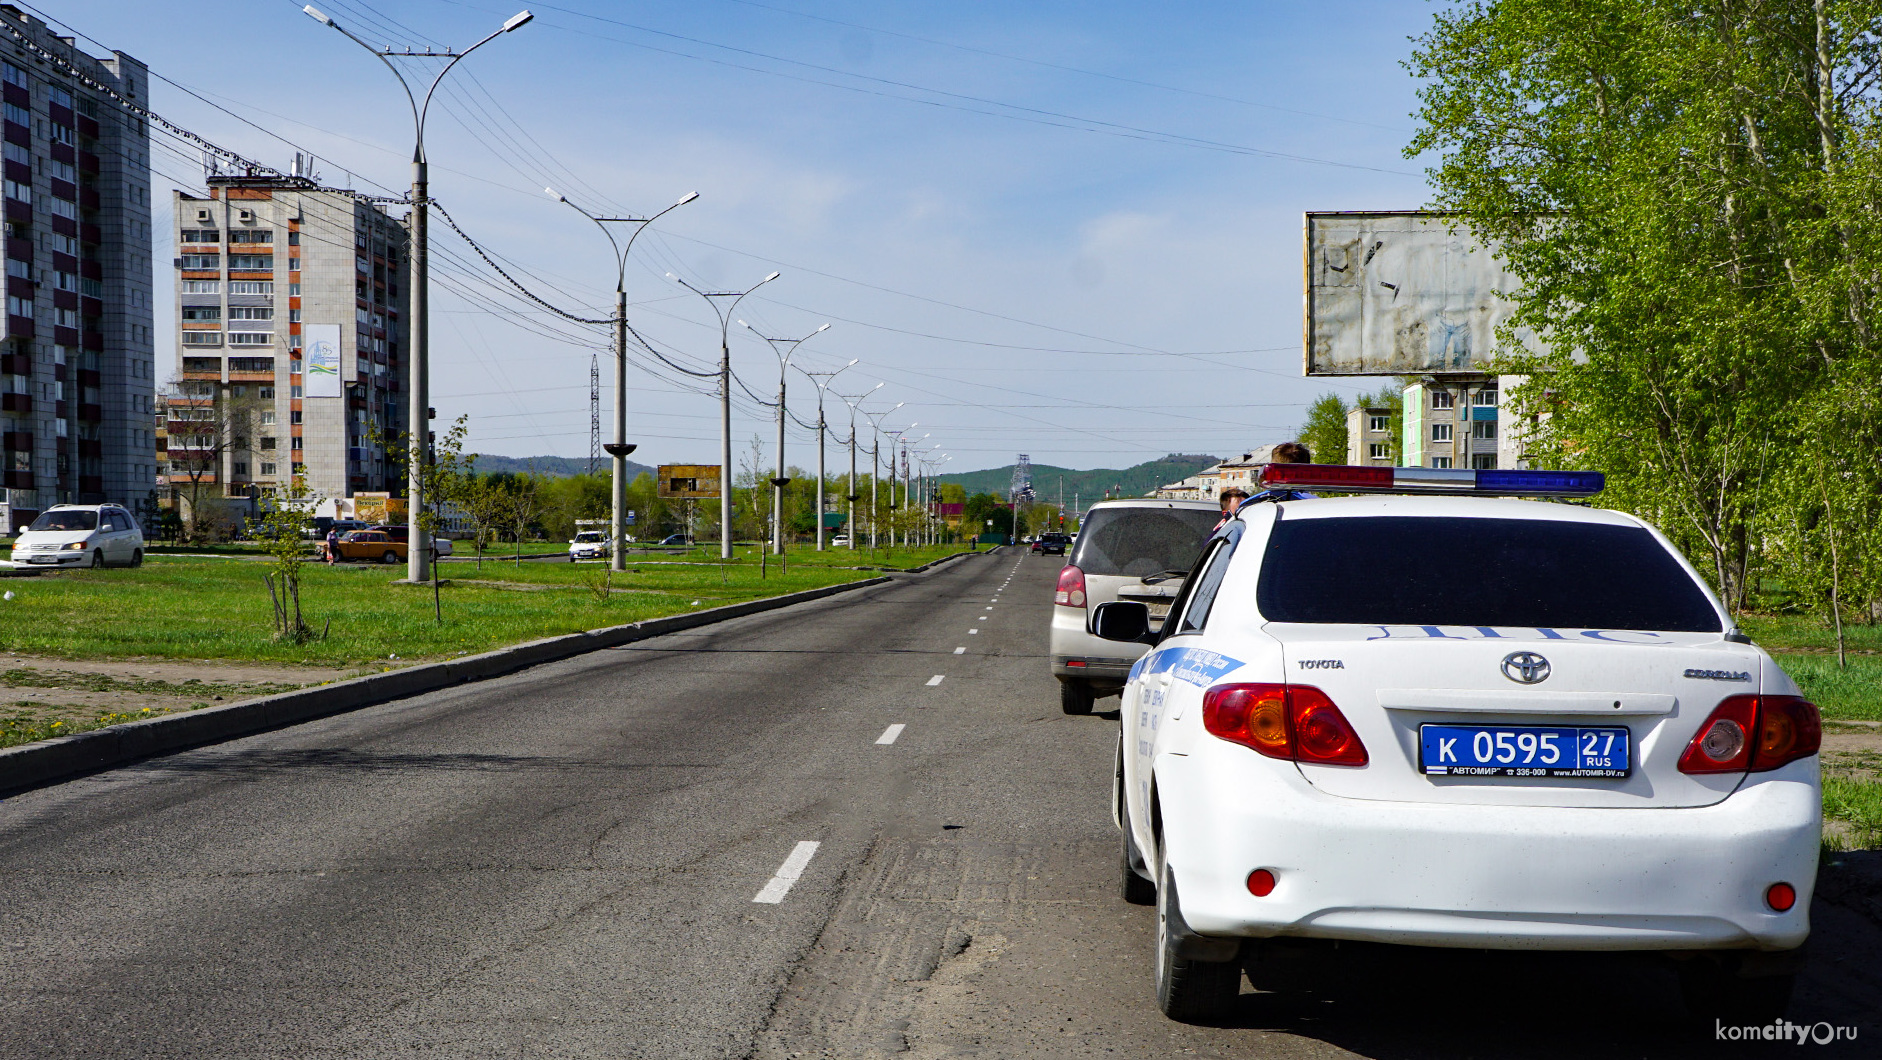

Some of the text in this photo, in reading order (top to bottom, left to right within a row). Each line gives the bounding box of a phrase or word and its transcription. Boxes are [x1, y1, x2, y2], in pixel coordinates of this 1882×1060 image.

[1298, 659, 1345, 670] TOYOTA
[1473, 731, 1561, 764] 0595
[1581, 732, 1616, 756] 27
[1586, 757, 1612, 767] RUS
[1516, 768, 1547, 776] 336-000
